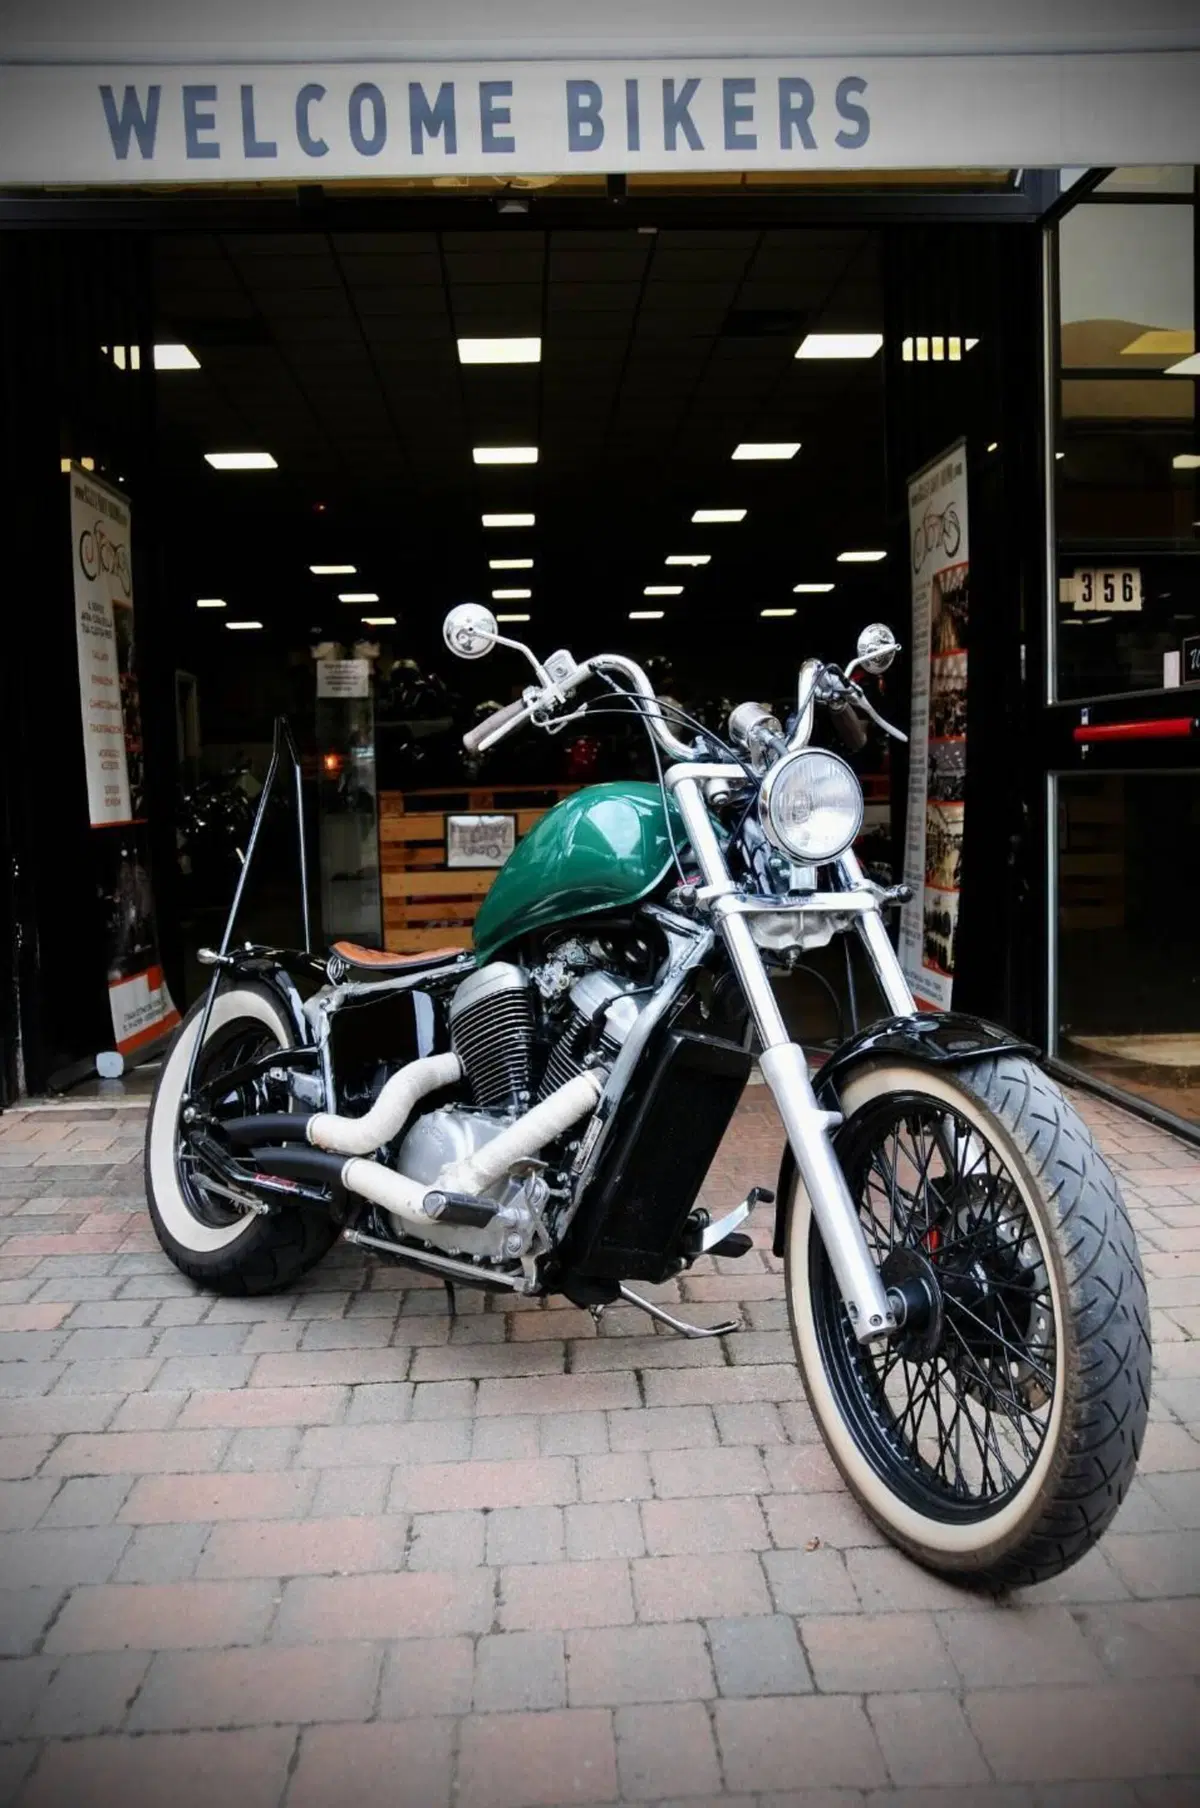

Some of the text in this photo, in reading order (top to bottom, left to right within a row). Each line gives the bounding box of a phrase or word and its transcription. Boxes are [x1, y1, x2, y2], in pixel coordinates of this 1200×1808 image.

[98, 75, 872, 160] WELCOME BIKERS
[1081, 572, 1134, 603] 356
